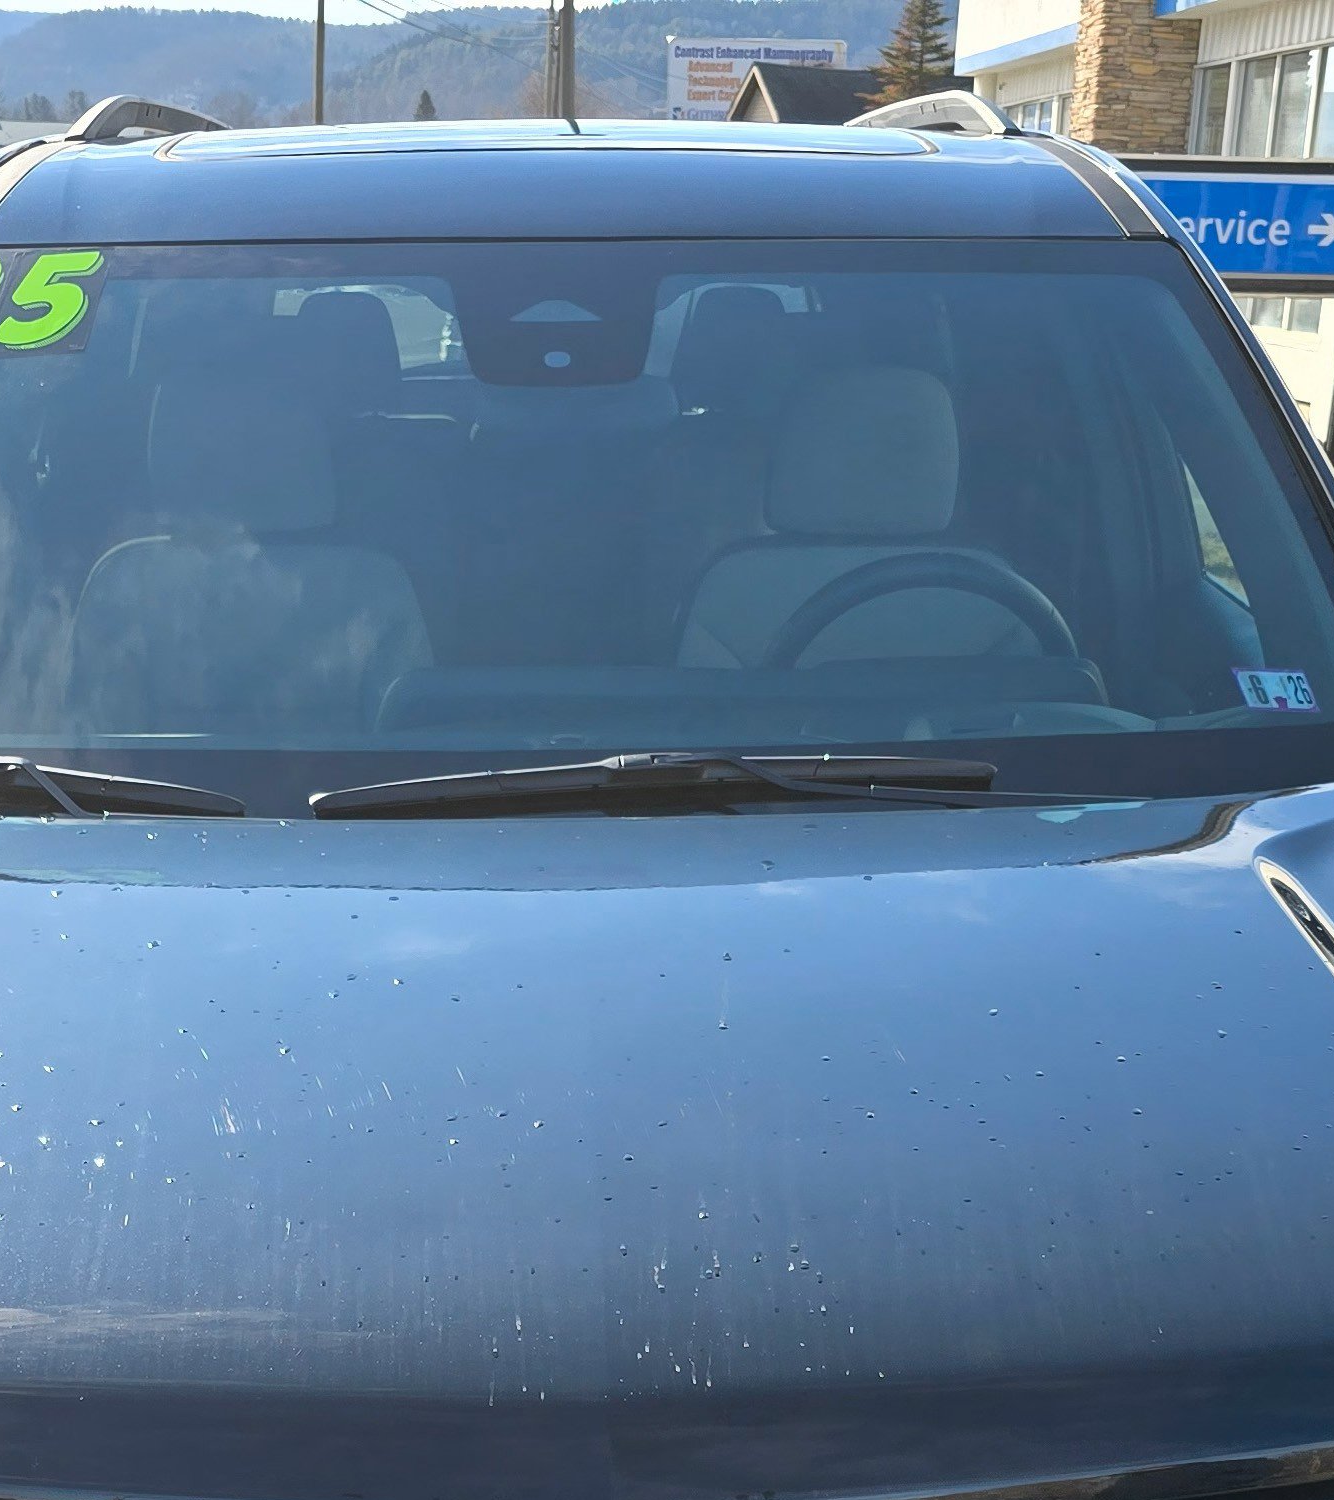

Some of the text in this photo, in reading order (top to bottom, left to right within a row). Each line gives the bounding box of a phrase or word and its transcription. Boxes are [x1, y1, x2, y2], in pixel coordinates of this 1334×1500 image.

[674, 45, 834, 63] Contrast Enhanced Mammography
[1248, 674, 1313, 705] 6 26
